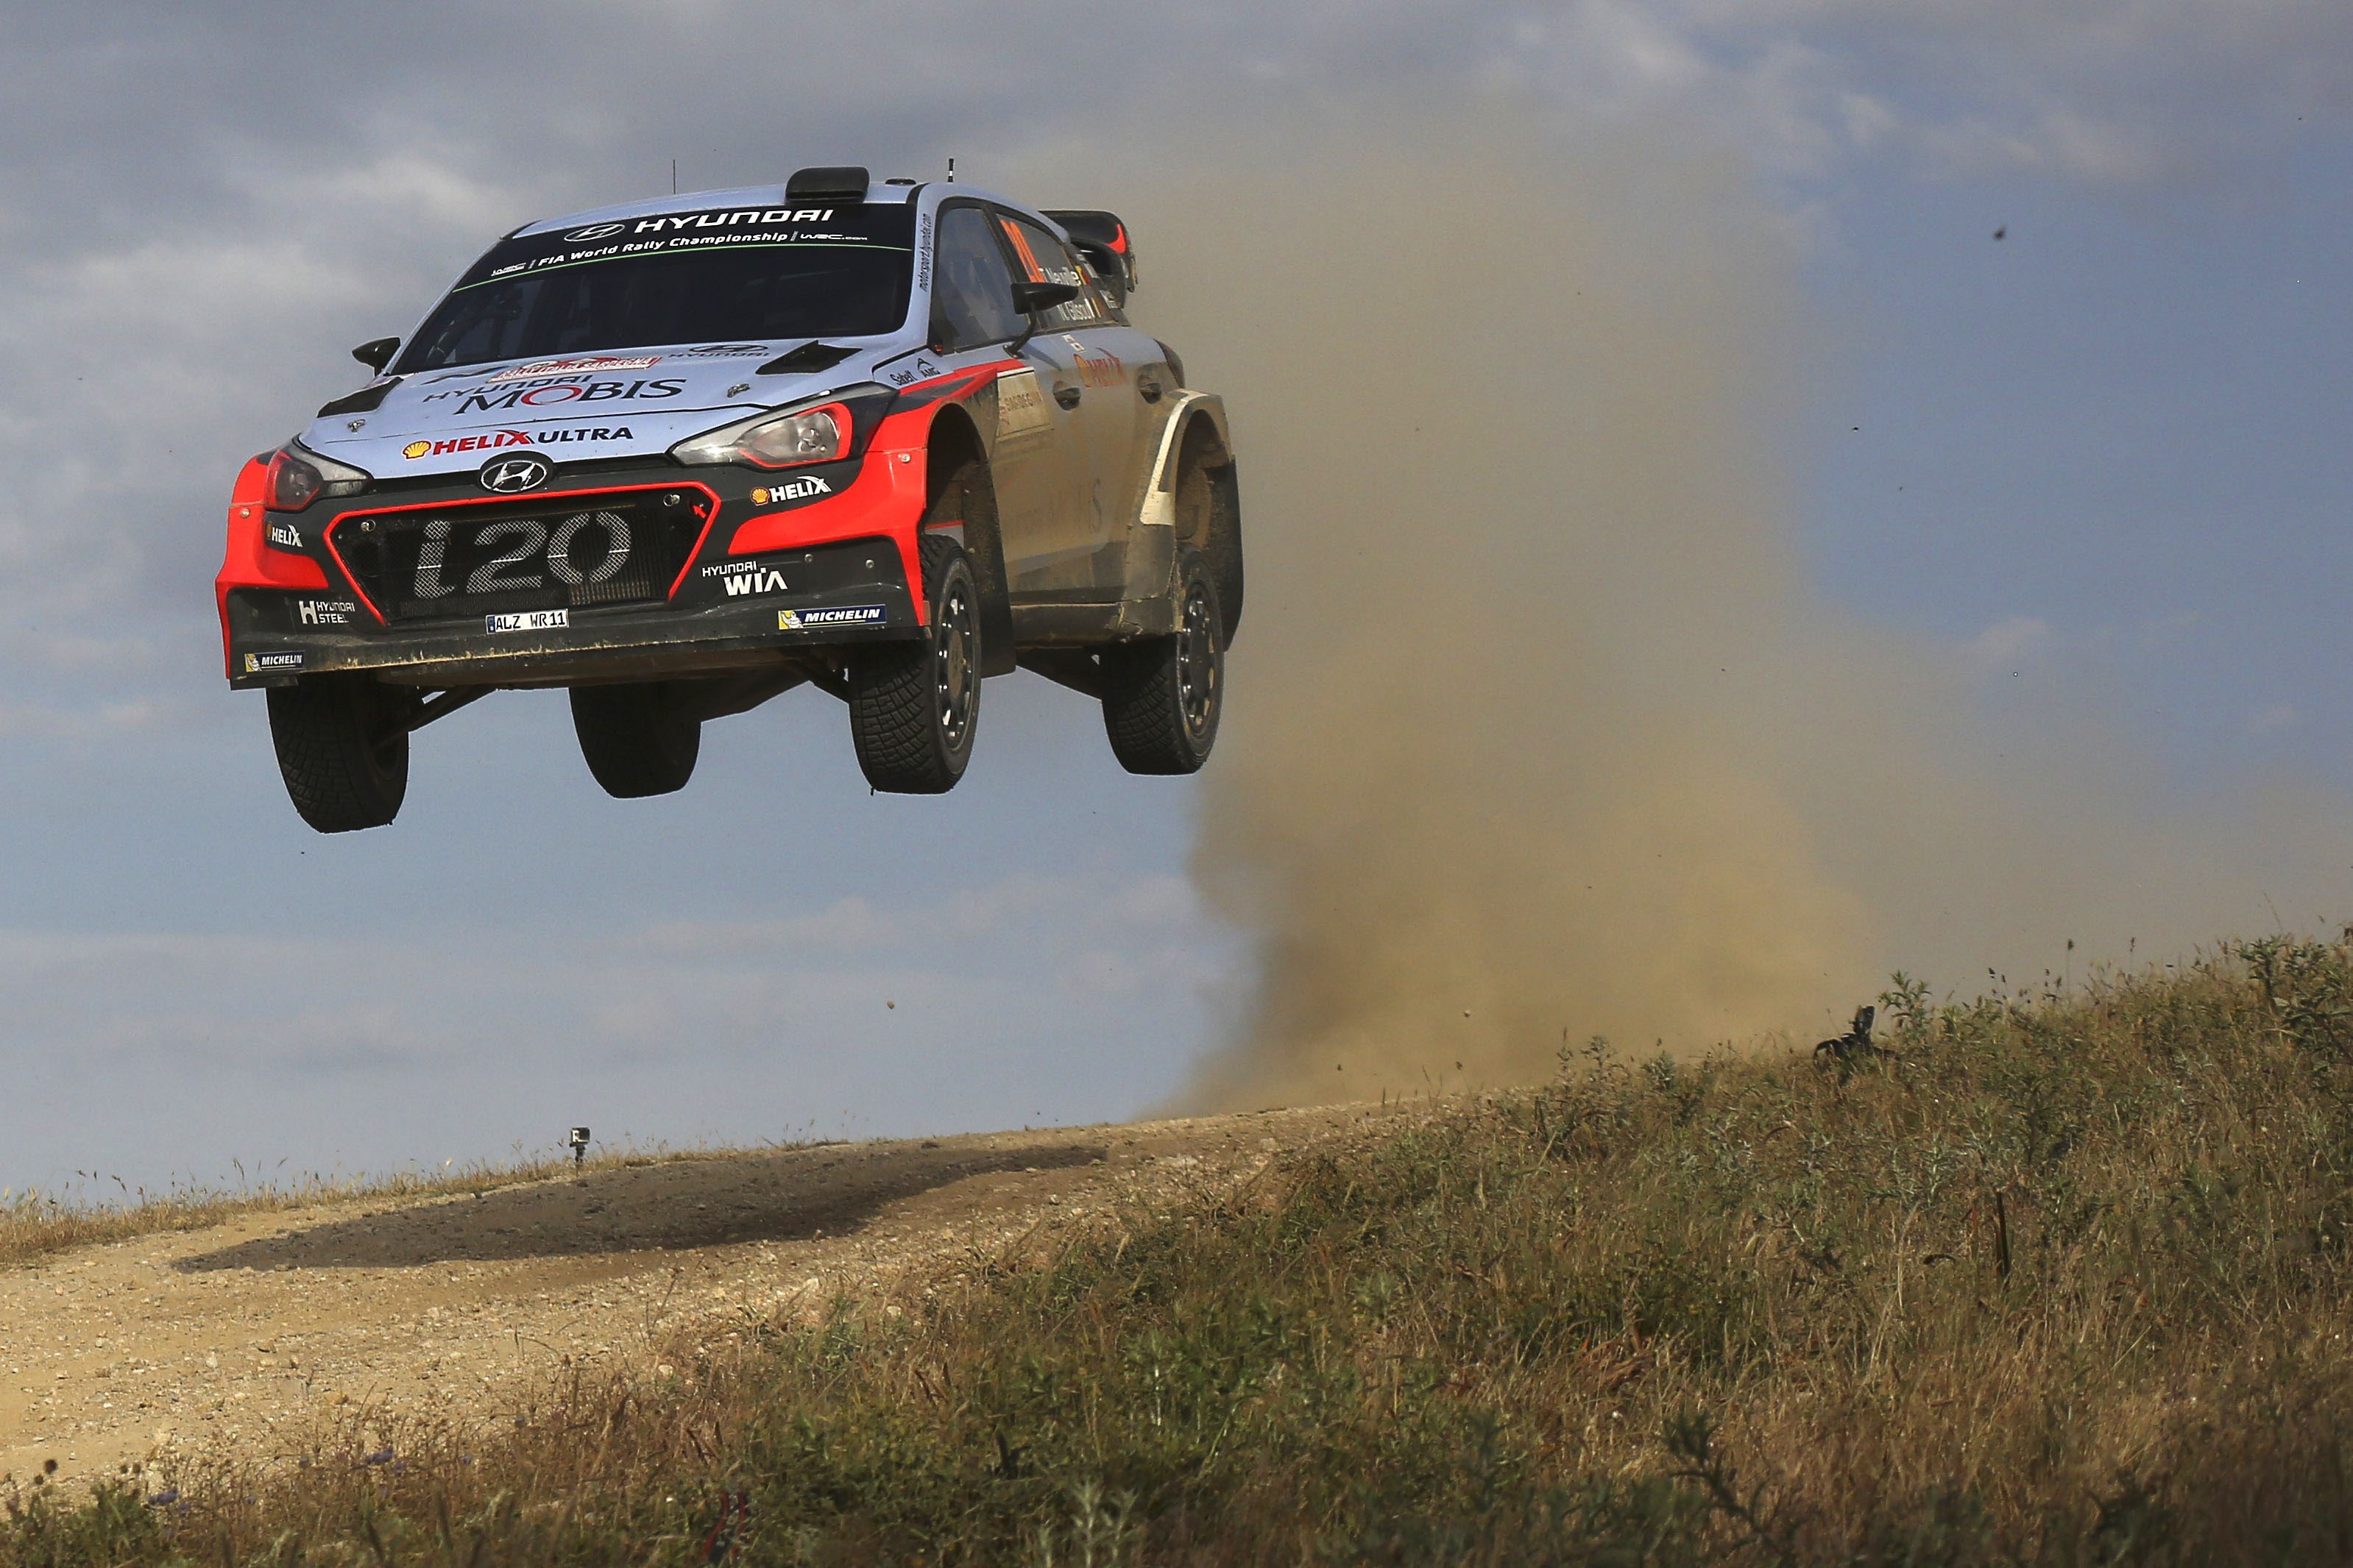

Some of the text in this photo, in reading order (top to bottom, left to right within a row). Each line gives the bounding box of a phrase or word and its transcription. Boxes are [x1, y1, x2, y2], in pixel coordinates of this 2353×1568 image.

[634, 209, 833, 233] HYUNDAI
[538, 255, 565, 266] FIA
[570, 244, 618, 260] World
[622, 240, 665, 252] Rally
[669, 232, 788, 247] Championship
[422, 375, 593, 403] HYUNDAI
[452, 379, 687, 416] MOBIS
[432, 427, 634, 455] HELIX ULTRA
[768, 475, 832, 503] HELIX
[271, 524, 303, 547] HELIX
[701, 561, 758, 578] HYUNDAI
[316, 602, 355, 612] HYUNDAI
[319, 614, 350, 623] STEEL
[804, 609, 881, 623] MICHELIN
[495, 611, 566, 631] ALZ WR11
[261, 654, 302, 666] MICHELIN
